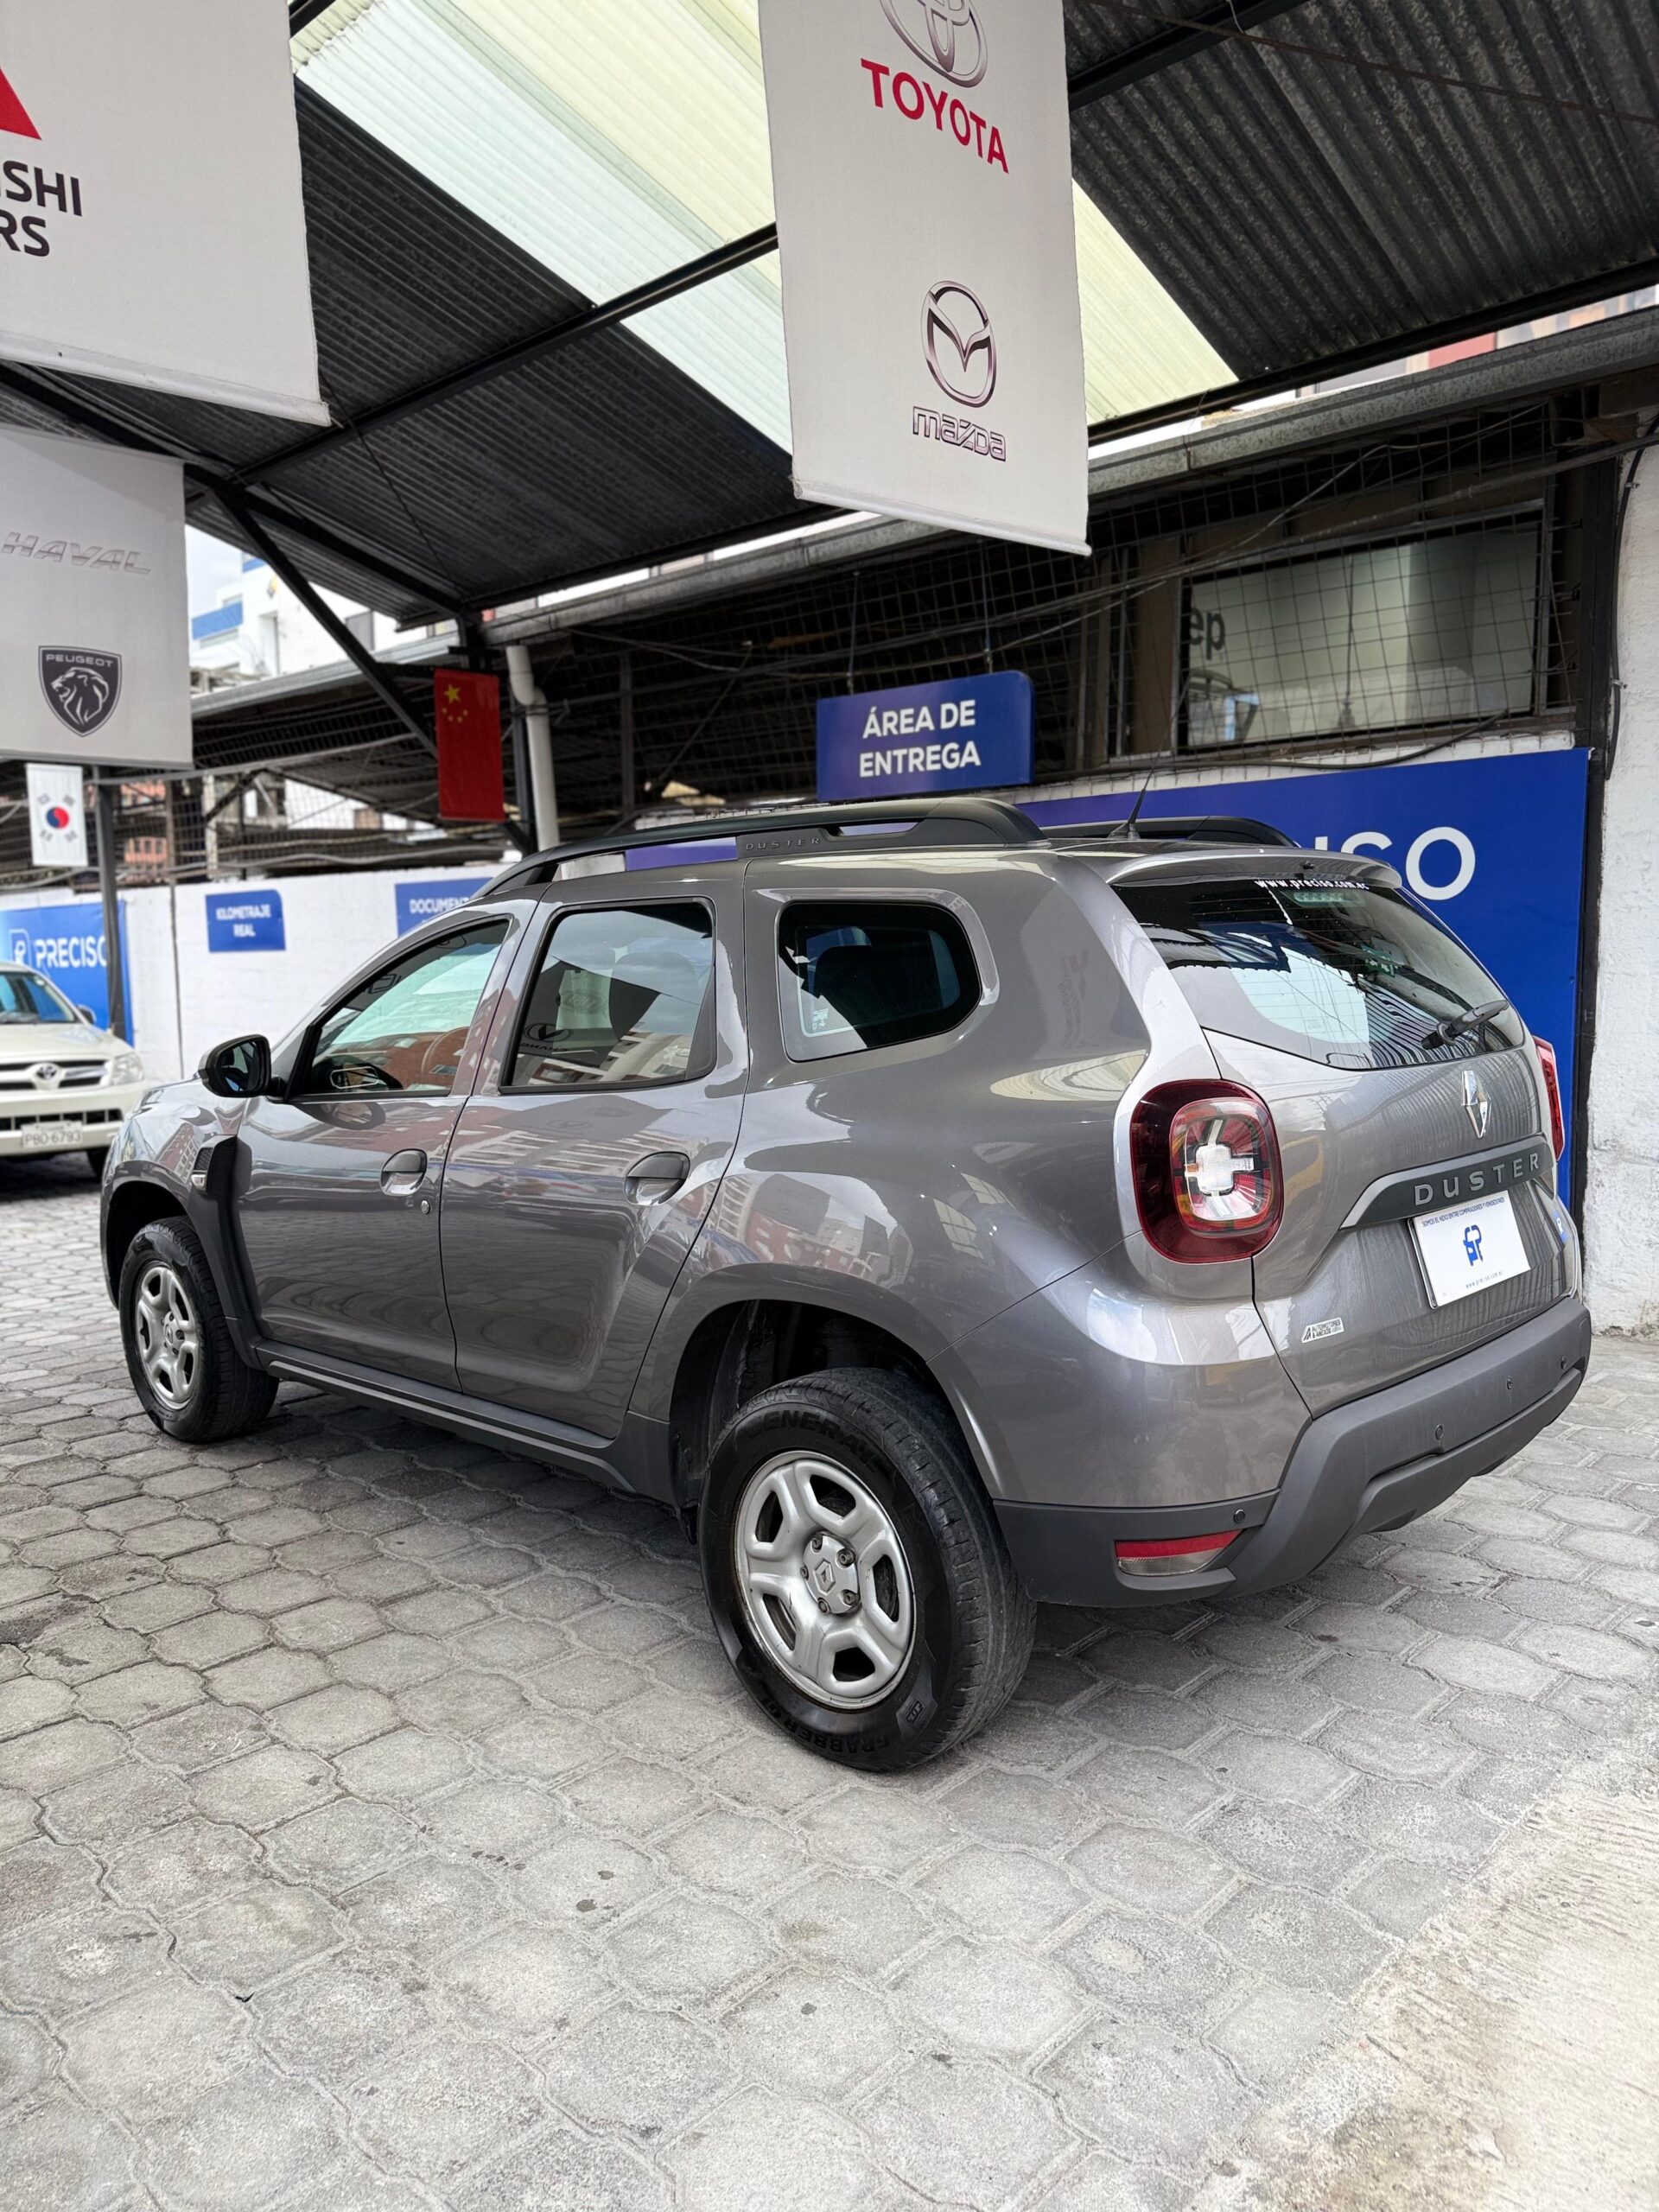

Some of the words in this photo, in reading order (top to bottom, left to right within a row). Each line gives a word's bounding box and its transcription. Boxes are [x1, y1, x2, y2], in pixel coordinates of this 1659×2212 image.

[861, 58, 1009, 175] TOYOTA
[1, 531, 151, 575] HAVAL
[45, 653, 114, 668] PEUGEOT
[862, 705, 935, 740] ÁREA
[939, 698, 976, 730] DE
[859, 740, 982, 778] ENTREGA
[745, 837, 822, 851] DUSTER
[215, 904, 271, 920] KILOMETRAJE
[232, 923, 256, 938] REAL
[1414, 1152, 1539, 1206] DUSTER
